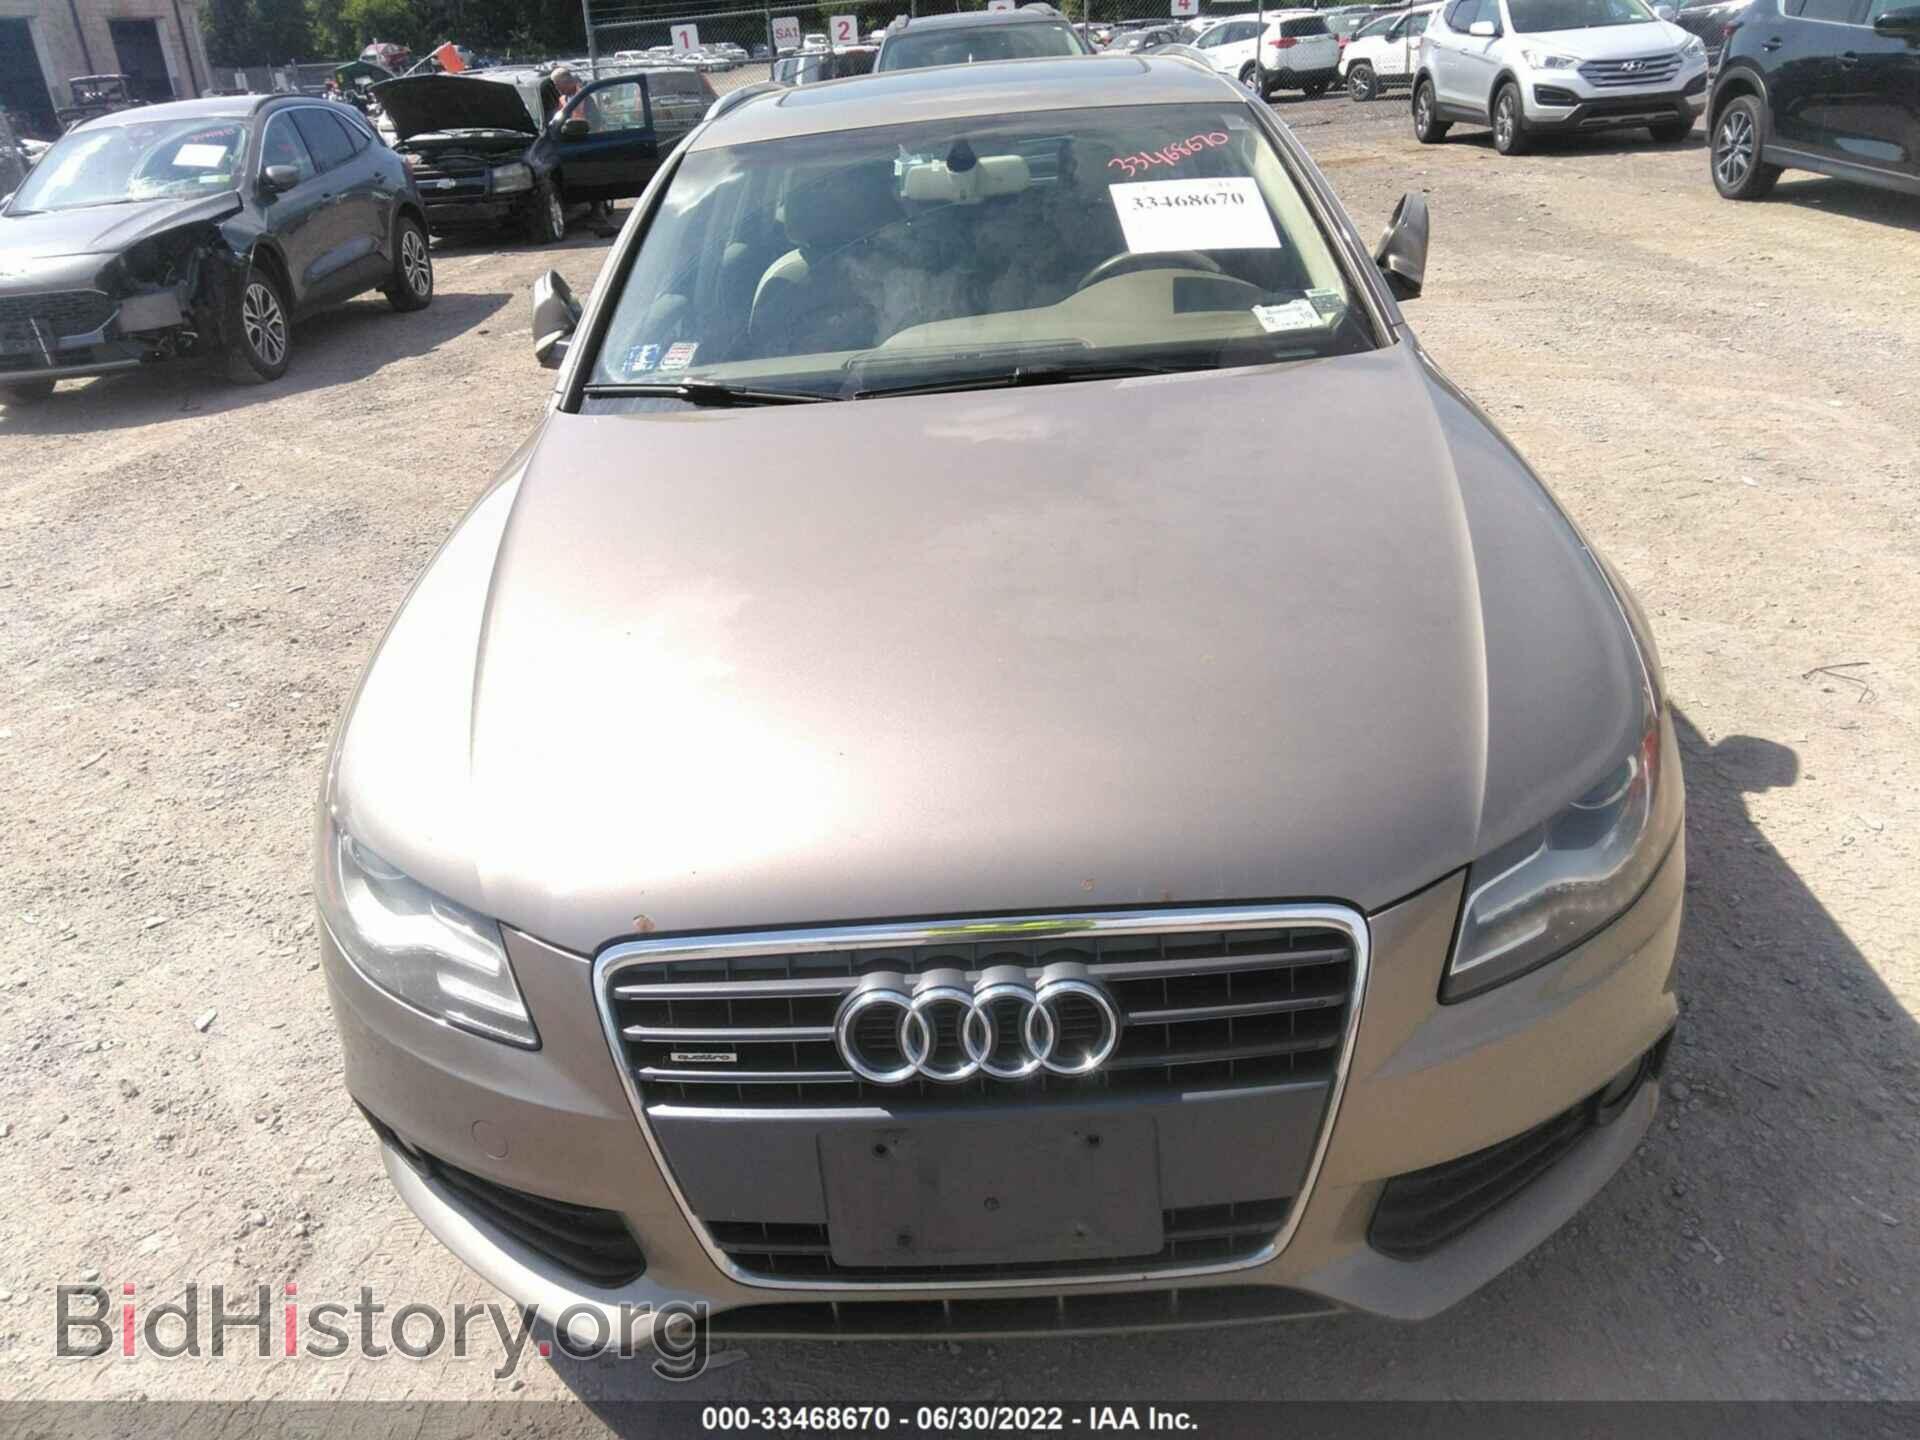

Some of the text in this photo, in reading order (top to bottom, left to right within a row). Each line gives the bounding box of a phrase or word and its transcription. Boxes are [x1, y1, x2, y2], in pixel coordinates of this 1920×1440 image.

[679, 31, 690, 49] 1
[776, 24, 800, 39] SA1
[837, 21, 851, 41] 2
[1108, 131, 1229, 177] 33468670
[1131, 192, 1246, 212] 33468670
